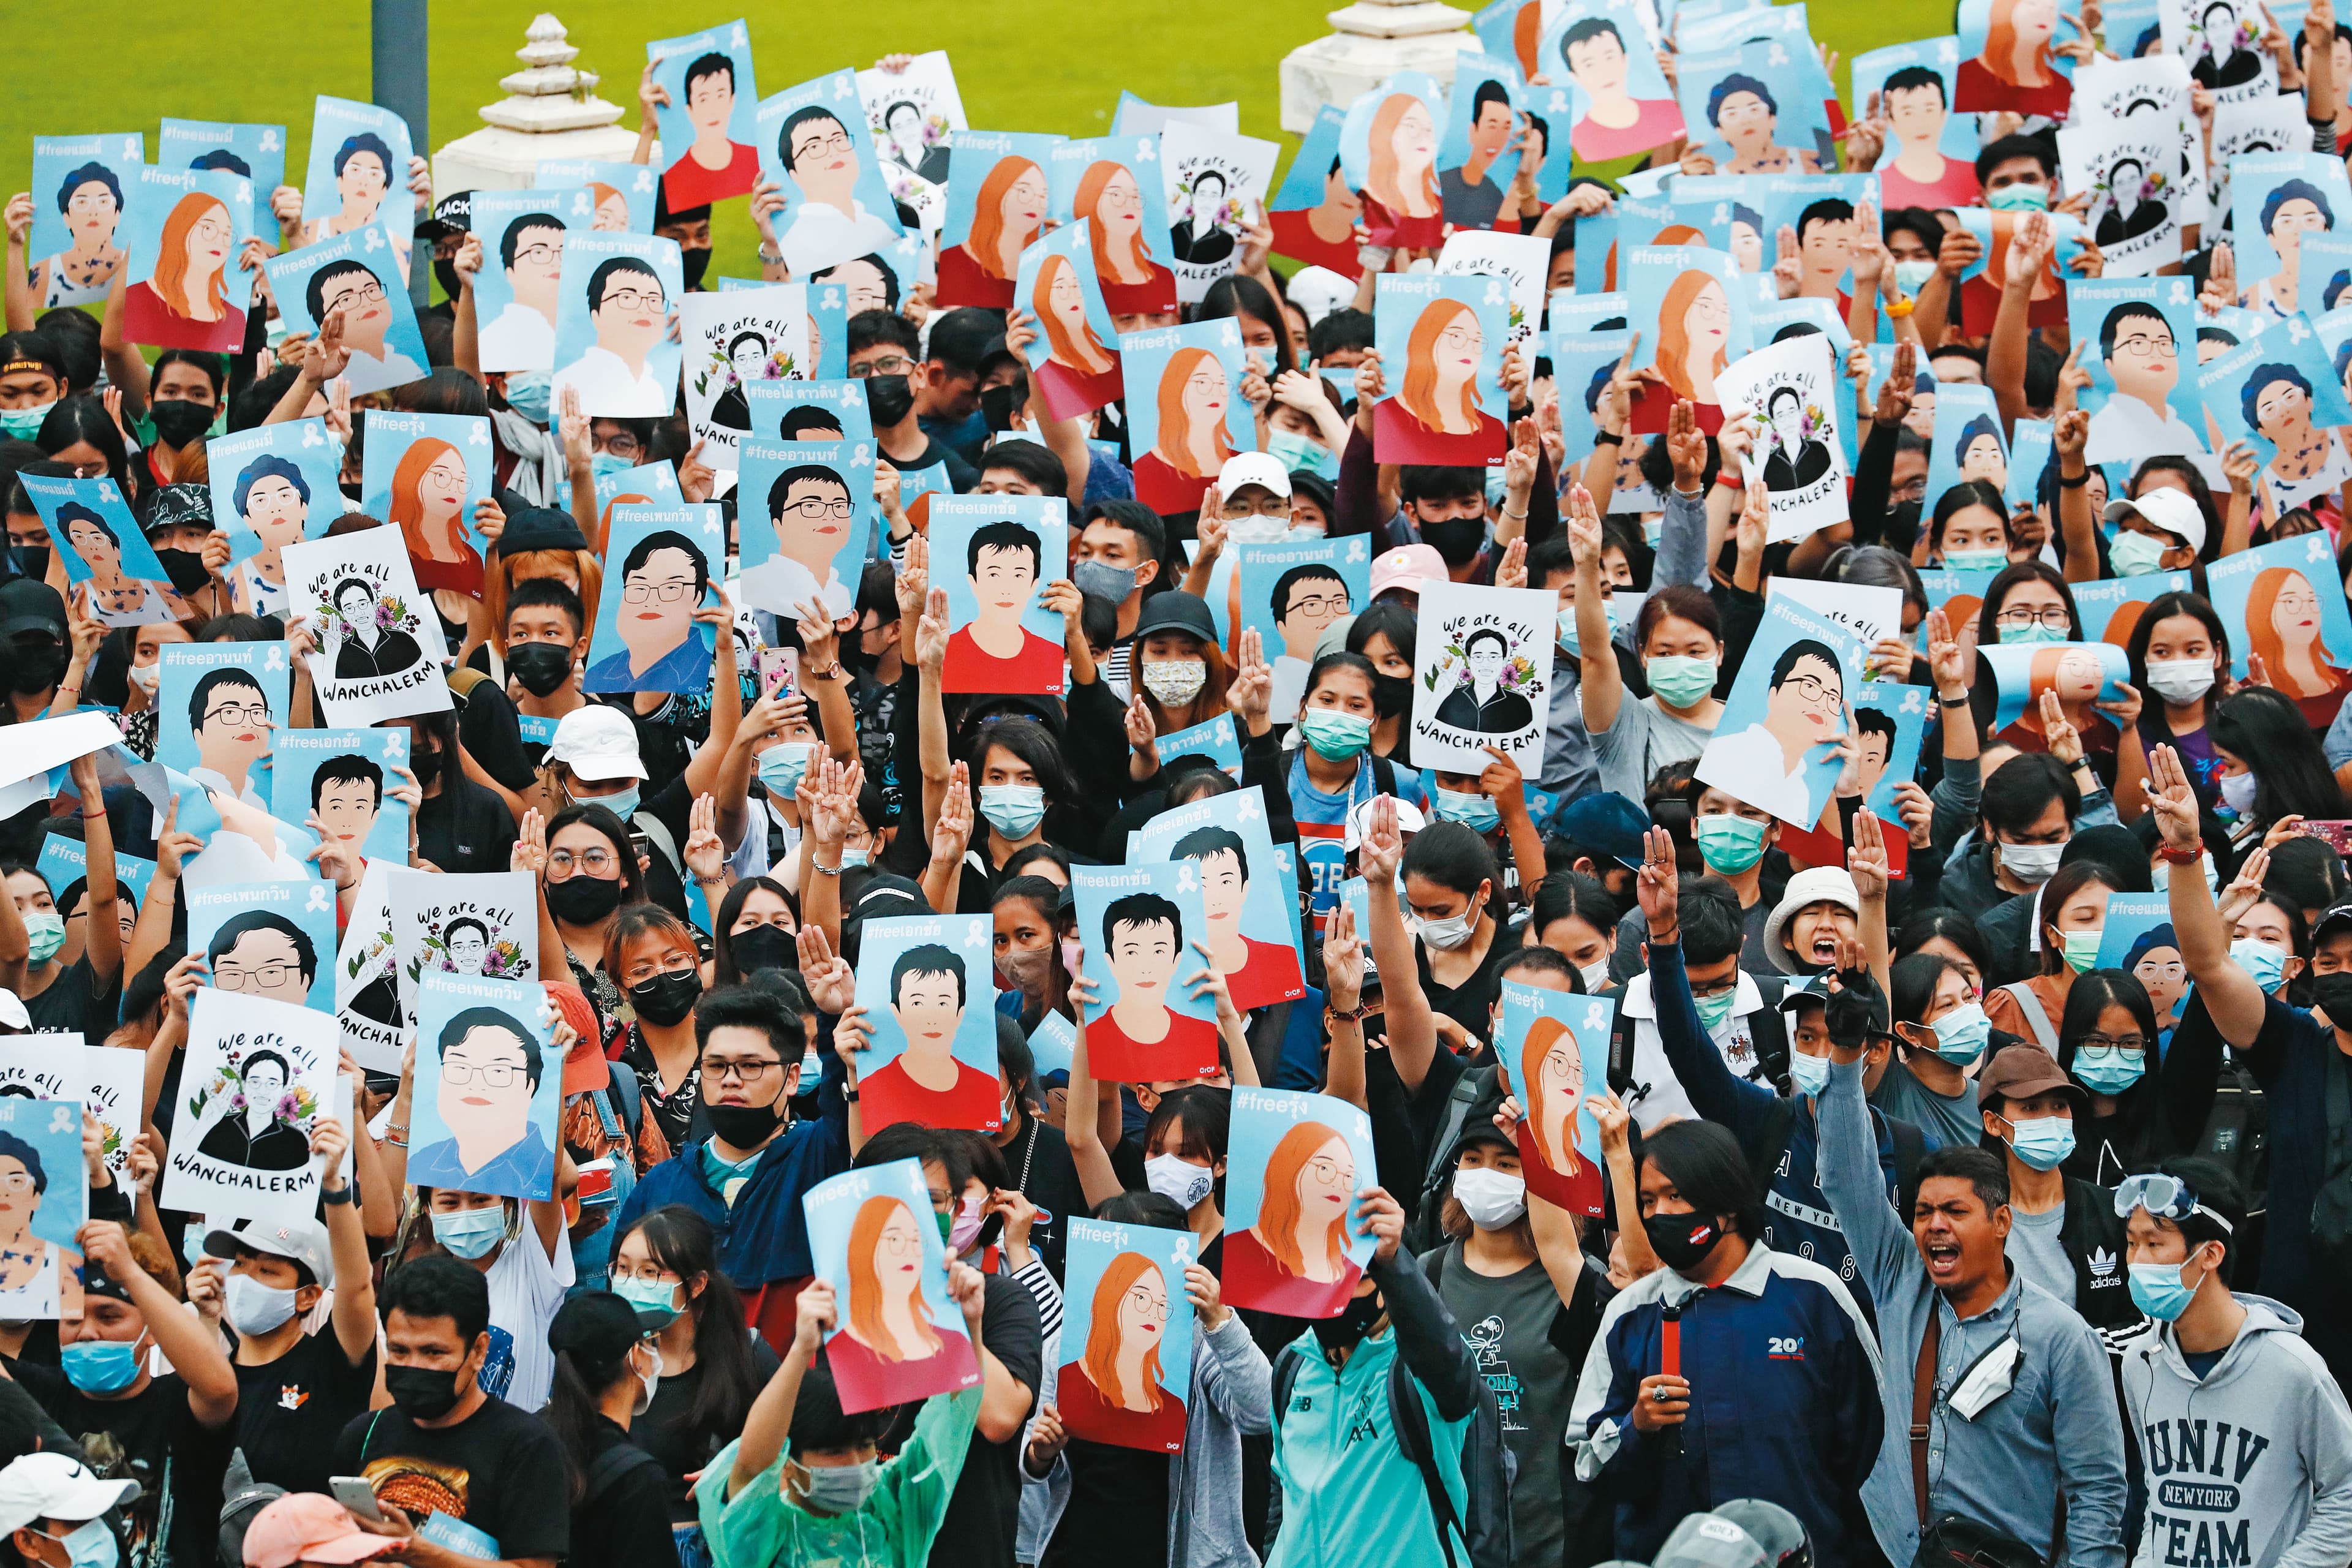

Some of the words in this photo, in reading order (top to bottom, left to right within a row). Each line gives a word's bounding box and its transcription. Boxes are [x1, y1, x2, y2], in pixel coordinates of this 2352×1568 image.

[1179, 157, 1197, 170] We
[1204, 156, 1225, 167] are
[1231, 167, 1249, 186] all
[1469, 258, 1493, 269] are
[1502, 267, 1525, 287] all
[706, 323, 727, 339] We
[733, 317, 758, 331] are
[764, 319, 788, 337] all
[1743, 383, 1761, 403] We
[1766, 372, 1789, 386] are
[1796, 374, 1815, 389] all
[369, 415, 426, 437] #freeรุ้ง
[745, 445, 840, 462] #freeอานนท์
[1770, 472, 1841, 513] NCHALERM
[616, 508, 693, 524] #freeเพนกวิน
[935, 497, 1018, 516] #freeเอกชัย
[1245, 545, 1335, 564] #freeอานนท์
[309, 573, 328, 595] We
[332, 563, 358, 579] are
[364, 564, 390, 582] all
[1444, 616, 1465, 633] We
[1474, 614, 1500, 627] are
[1507, 622, 1533, 643] all
[1772, 603, 1845, 650] #freeอานนท์
[1855, 620, 1880, 641] all
[166, 648, 252, 666] #freeอานนท์
[323, 662, 435, 702] WANCHALERM
[279, 734, 361, 750] #freeเอกชัย
[1074, 869, 1152, 888] #freeเอกชัย
[192, 888, 290, 908] #freeเพนกวิน
[418, 906, 442, 924] We
[448, 902, 478, 916] are
[486, 907, 514, 927] all
[425, 976, 522, 1003] #freeเพนกวิน
[1504, 986, 1544, 1015] #freeรุ้ง
[337, 1011, 404, 1046] ANCHAL
[219, 1033, 247, 1051] We
[254, 1032, 285, 1047] are
[292, 1045, 317, 1071] all
[36, 1074, 63, 1095] all
[91, 1085, 119, 1107] all
[1237, 1093, 1308, 1120] #freeรุ้ง
[173, 1152, 314, 1194] WANCHALERM
[1774, 1197, 1802, 1216] NEW
[1071, 1223, 1129, 1250] #freeรุ้ง
[2090, 1276, 2122, 1289] adidas
[1487, 1376, 1523, 1393] ONG,
[2146, 1419, 2269, 1483] UNIV
[2151, 1516, 2253, 1568] TEAM
